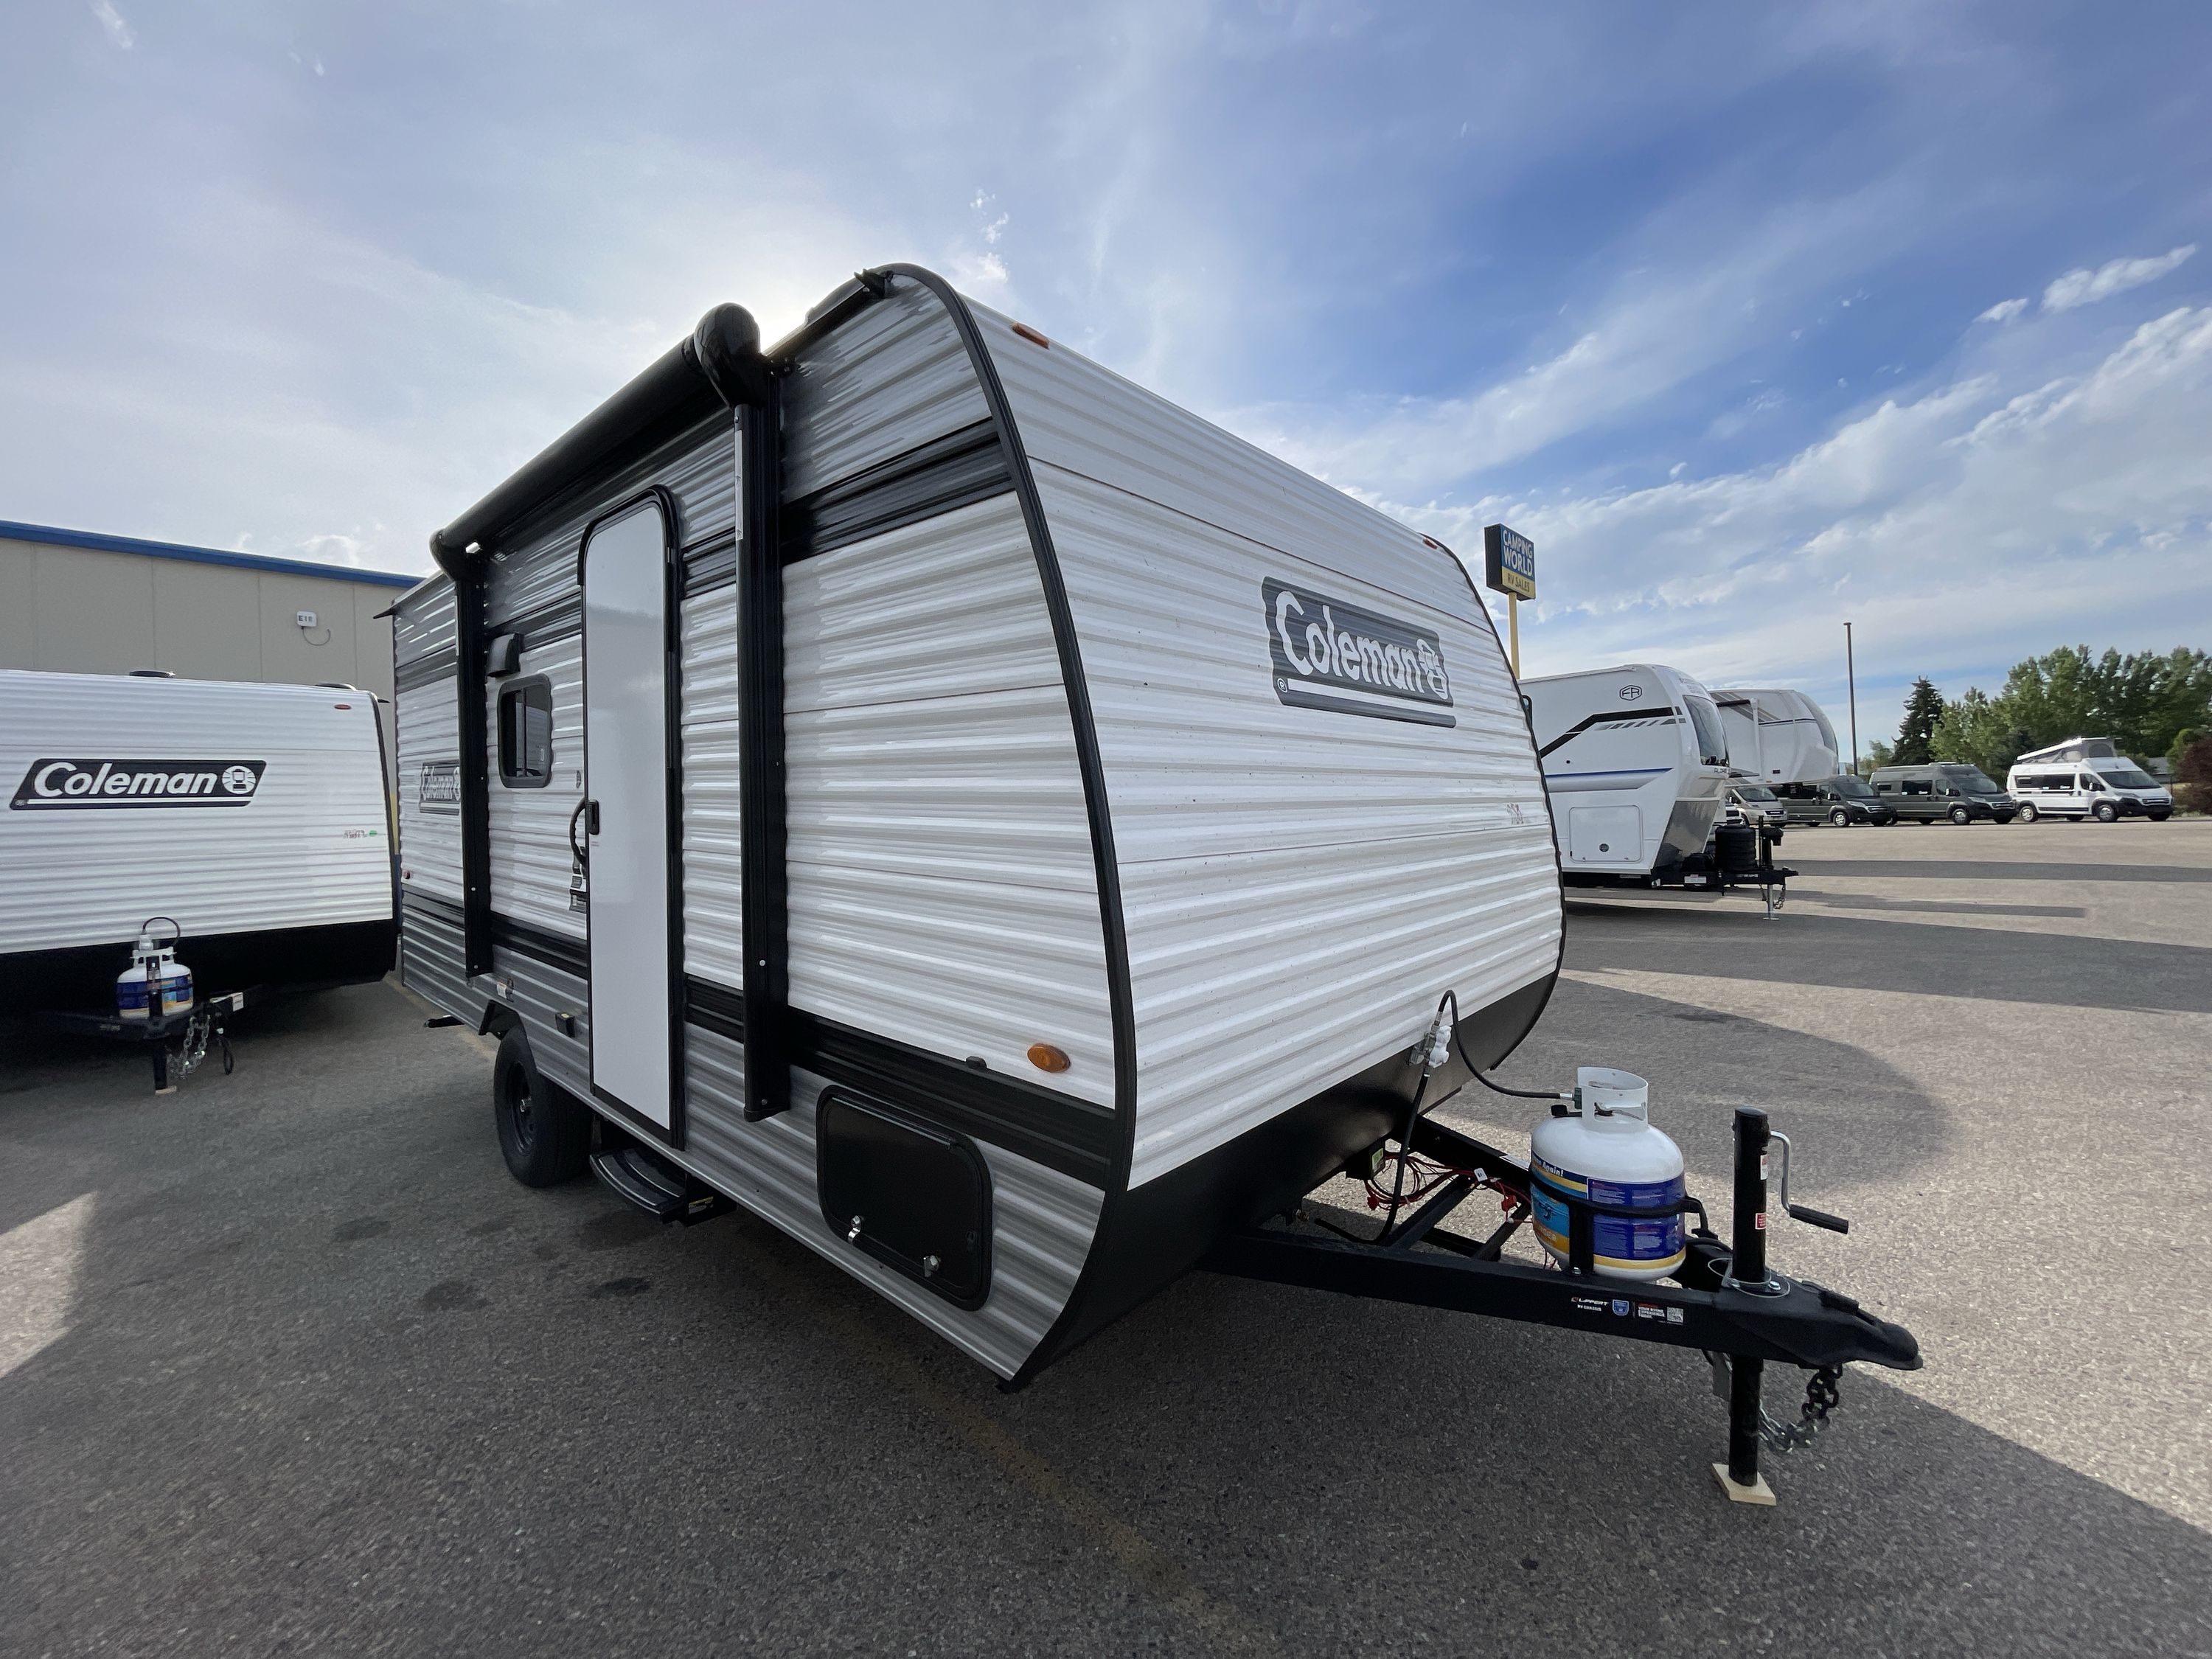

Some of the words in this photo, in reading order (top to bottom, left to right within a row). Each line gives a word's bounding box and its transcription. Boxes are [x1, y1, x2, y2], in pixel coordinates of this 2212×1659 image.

[1503, 529, 1533, 558] CAMPING
[1503, 546, 1533, 576] WORLD
[1507, 572, 1514, 585] RV
[1515, 576, 1530, 592] SALES
[1276, 591, 1425, 694] Coleman
[33, 762, 218, 797] Coleman
[1542, 1161, 1564, 1178] Again!
[1579, 1298, 1610, 1306] LIPPERT
